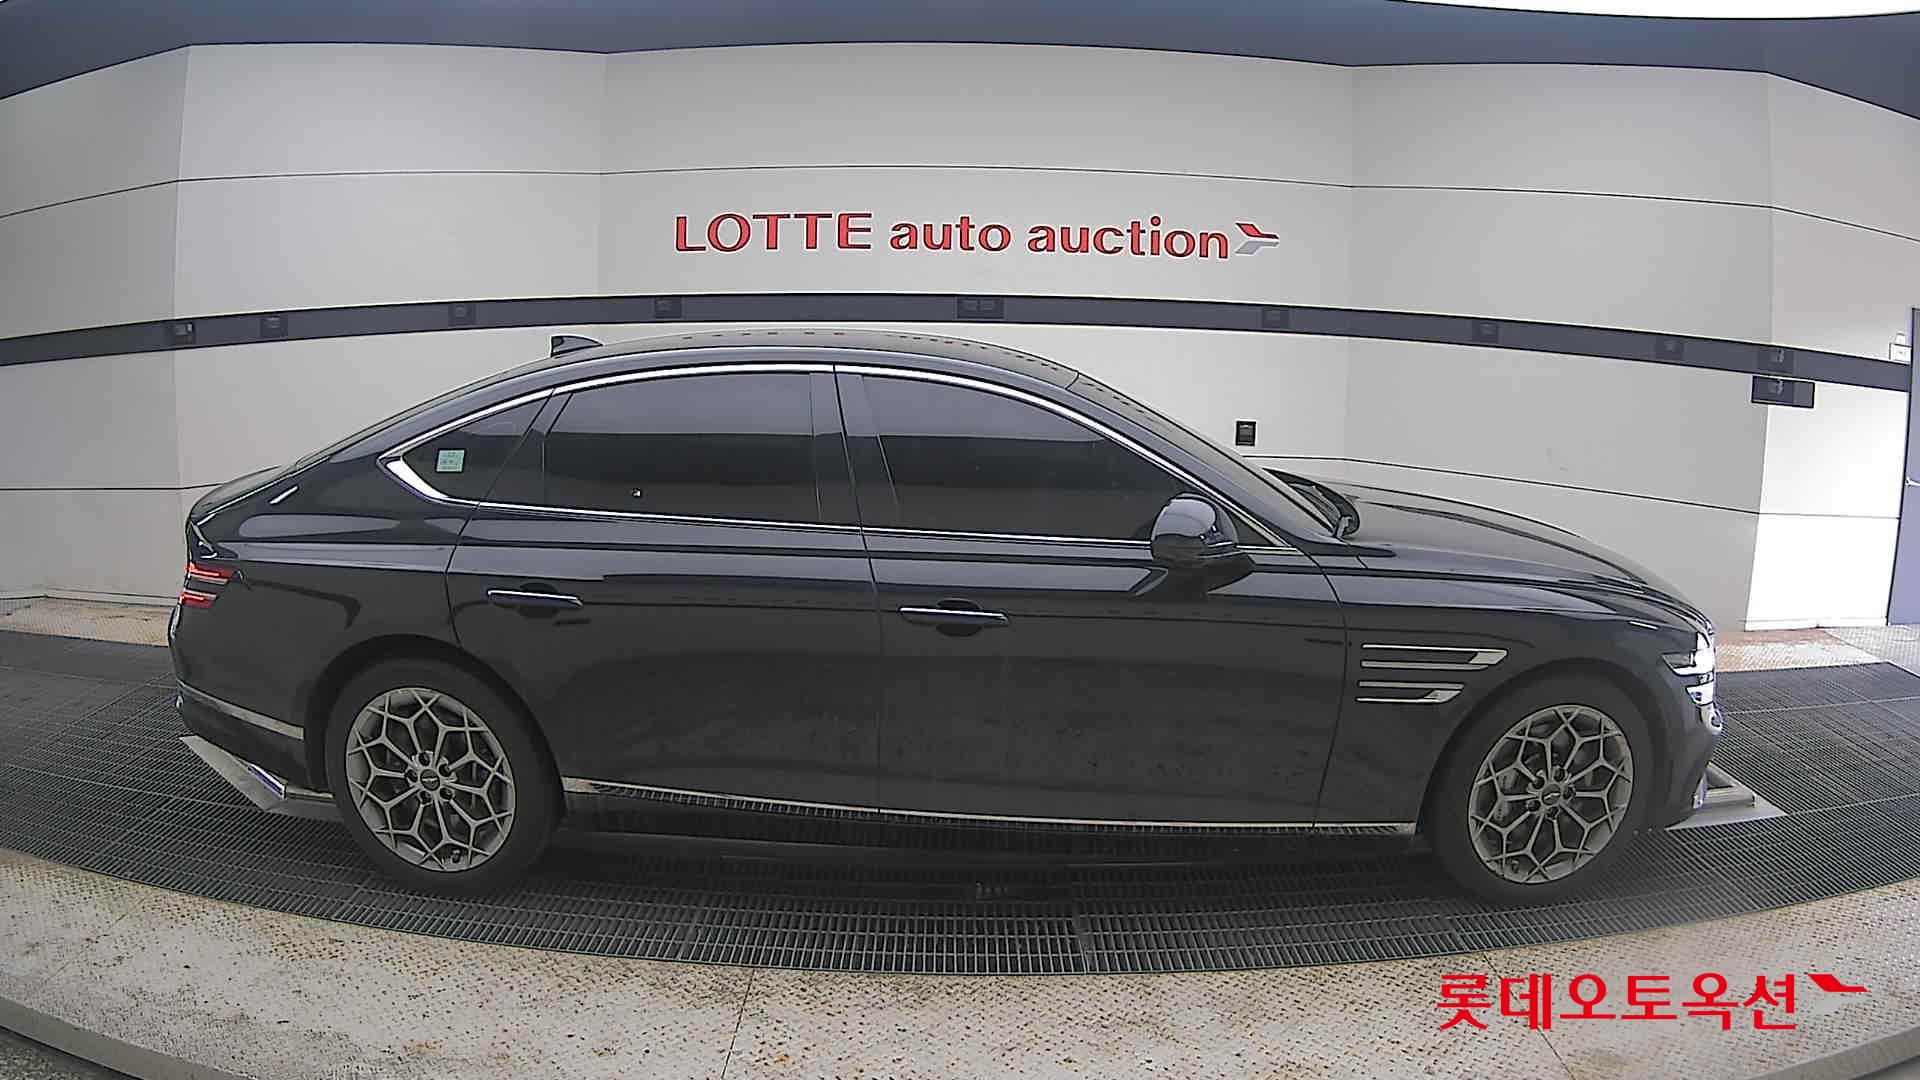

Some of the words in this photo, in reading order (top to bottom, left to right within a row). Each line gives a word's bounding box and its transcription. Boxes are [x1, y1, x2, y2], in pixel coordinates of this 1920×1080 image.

[676, 213, 873, 251] LOTTE
[889, 216, 1012, 252] auto
[1028, 216, 1229, 258] auction
